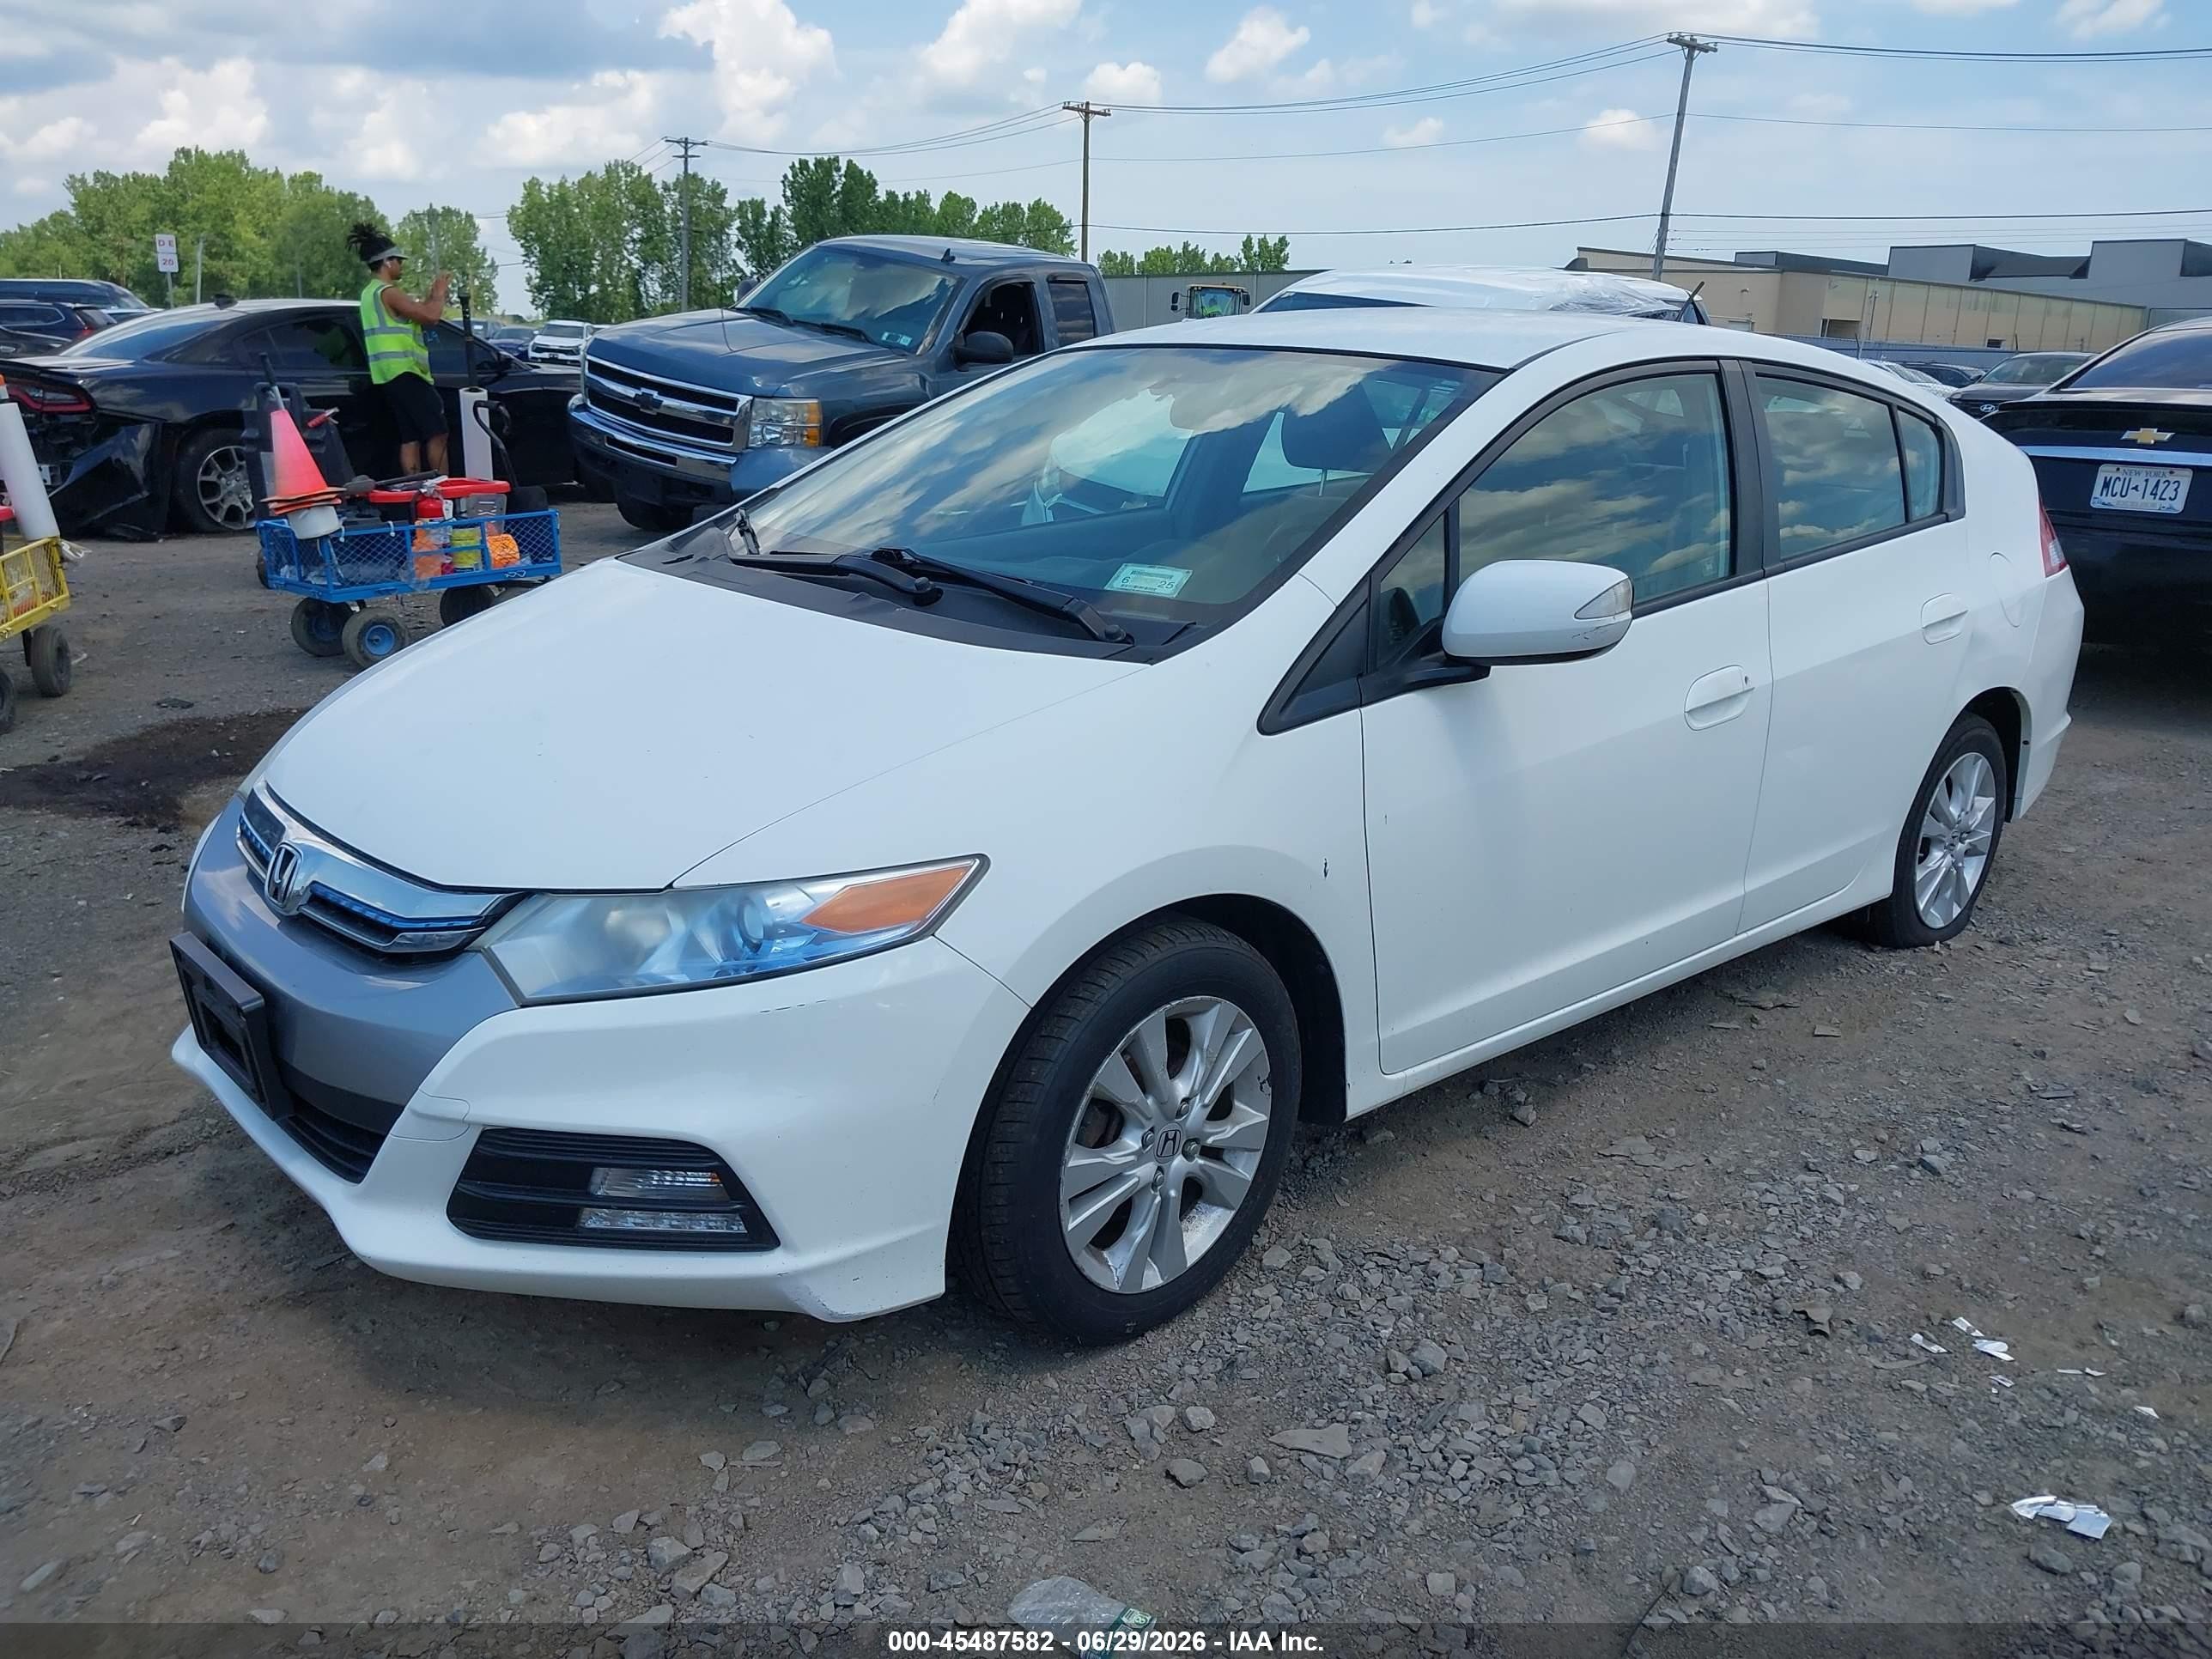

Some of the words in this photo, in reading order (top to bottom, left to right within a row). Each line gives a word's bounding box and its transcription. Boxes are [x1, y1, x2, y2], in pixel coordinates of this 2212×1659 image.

[2122, 468, 2143, 477] NEW
[2144, 470, 2167, 478] YORK
[2142, 478, 2181, 501] 1423
[1158, 581, 1176, 590] 25
